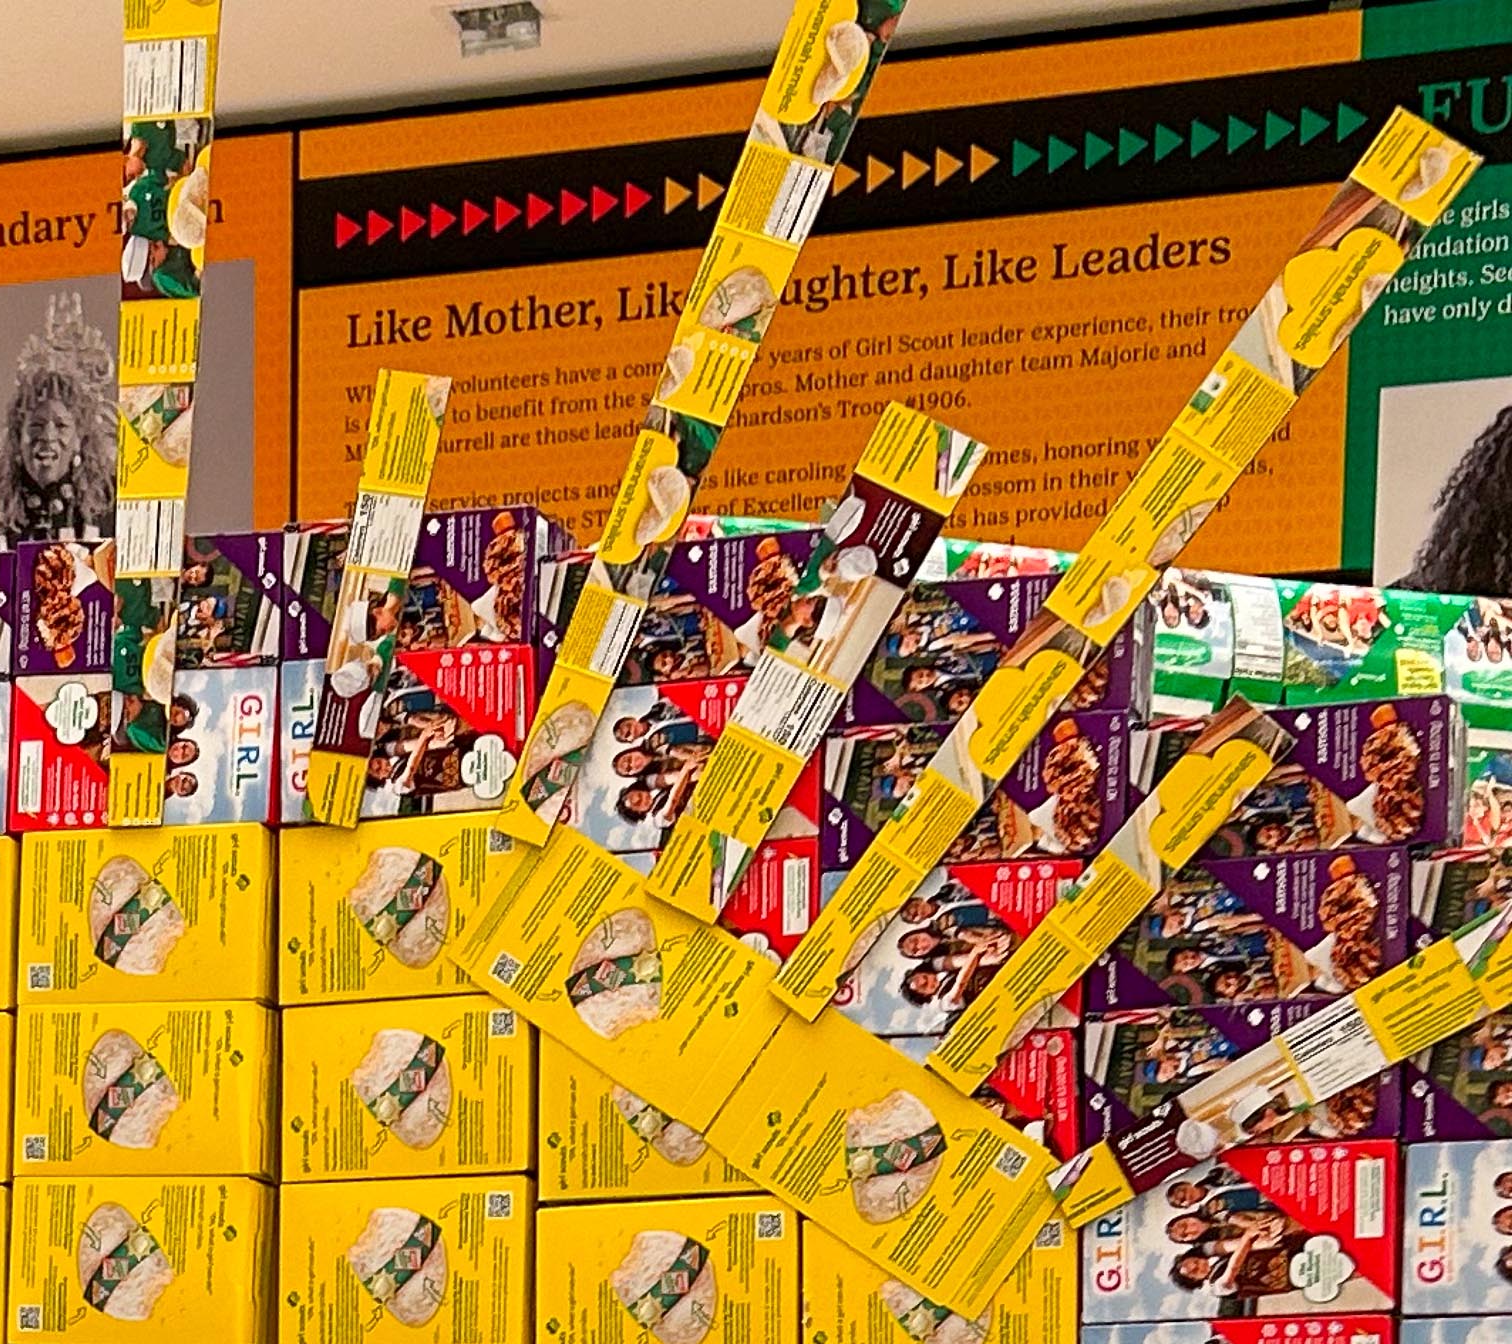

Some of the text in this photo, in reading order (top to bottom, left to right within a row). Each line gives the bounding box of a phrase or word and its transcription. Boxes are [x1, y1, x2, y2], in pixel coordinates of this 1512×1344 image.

[1460, 198, 1509, 227] girls
[348, 232, 1231, 348] Like Mother, Lik ughter, Like Leaders
[1384, 298, 1490, 325] have only
[555, 306, 1211, 386] have years of Girl Scout leader experience, their
[452, 406, 470, 424] to
[476, 398, 545, 422] benefit
[550, 395, 597, 416] from
[604, 391, 638, 409] the
[795, 372, 866, 393] Mother
[874, 367, 913, 384] and
[920, 355, 1017, 386] daughter
[1021, 350, 1073, 369] team
[1166, 338, 1206, 359] and
[500, 423, 588, 448] are those
[725, 438, 1139, 487] like caroling honoring
[1069, 468, 1120, 490] their
[973, 499, 1106, 525] has provided
[1417, 1171, 1449, 1285] G.I.R.L.
